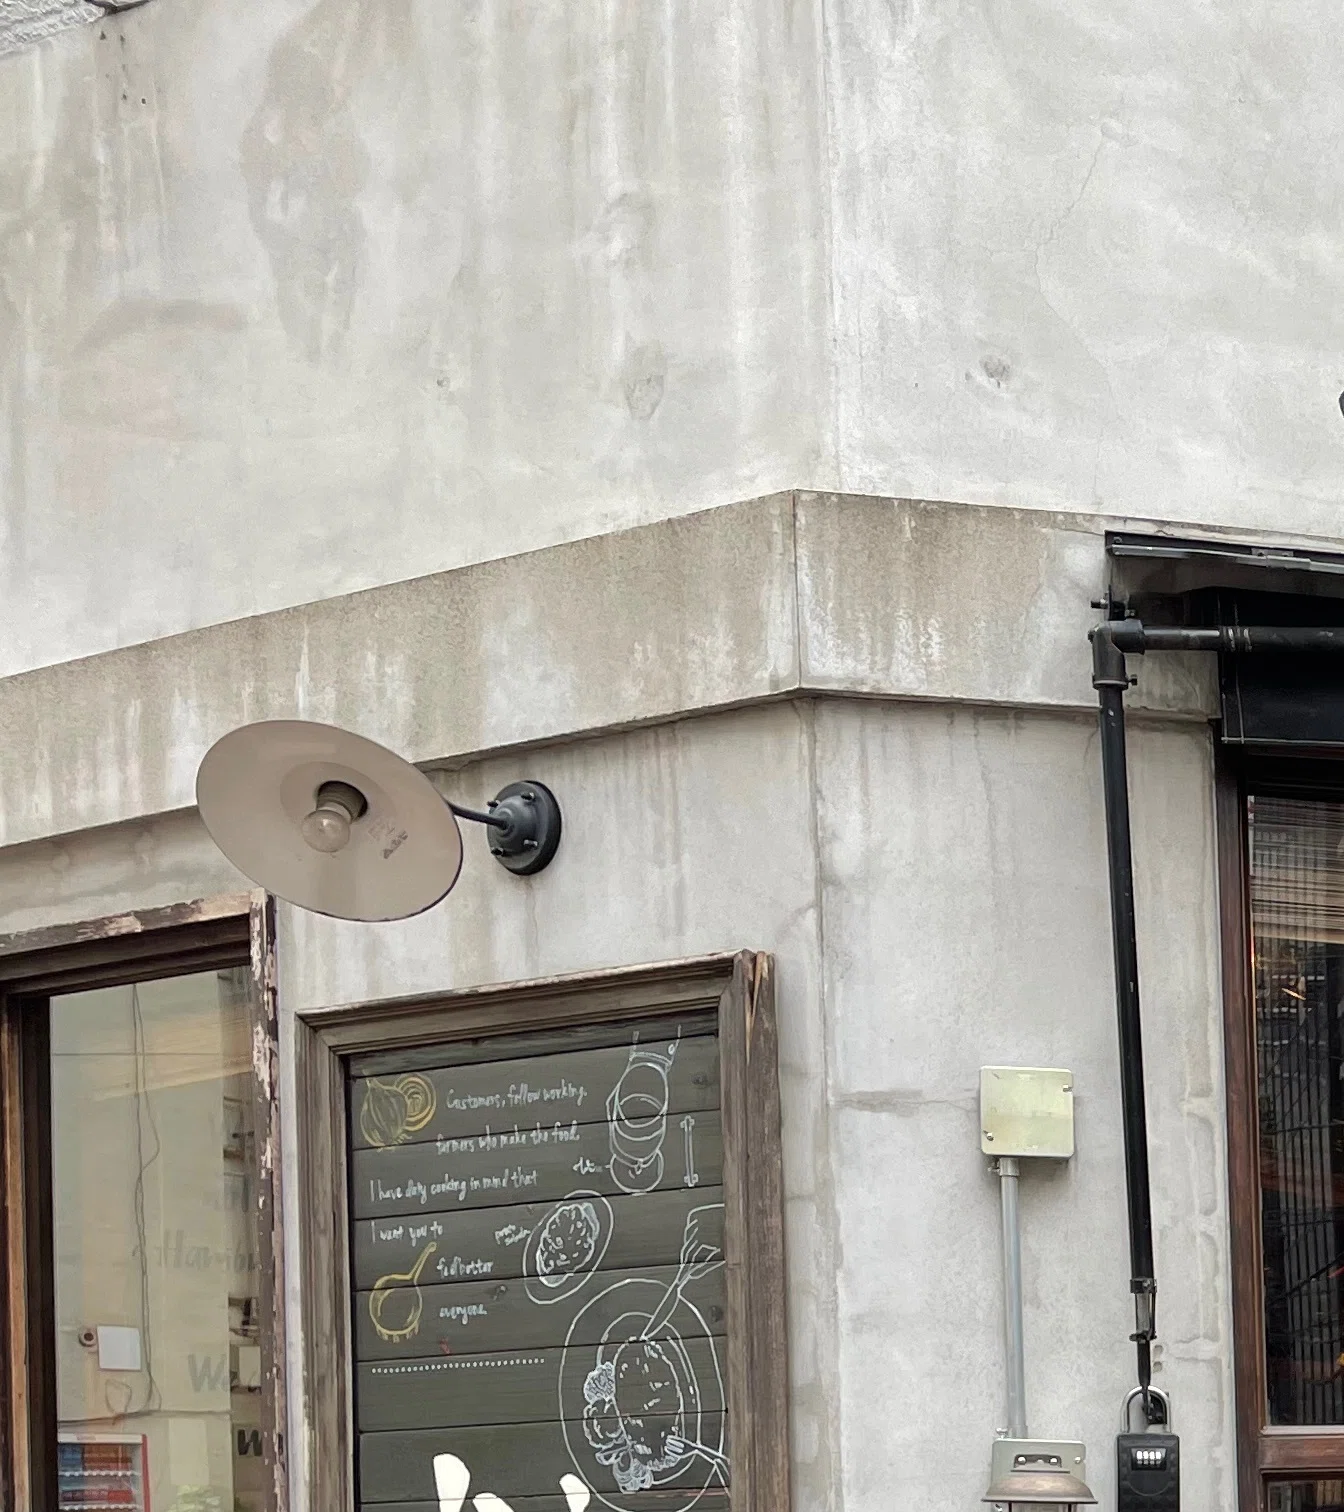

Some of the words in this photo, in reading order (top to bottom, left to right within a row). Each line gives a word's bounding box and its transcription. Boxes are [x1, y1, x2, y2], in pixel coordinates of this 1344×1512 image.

[500, 1124, 527, 1148] make
[529, 1121, 549, 1145] the
[377, 1179, 403, 1201] have
[511, 1166, 538, 1188] that
[408, 1225, 429, 1247] you
[430, 1220, 444, 1240] to
